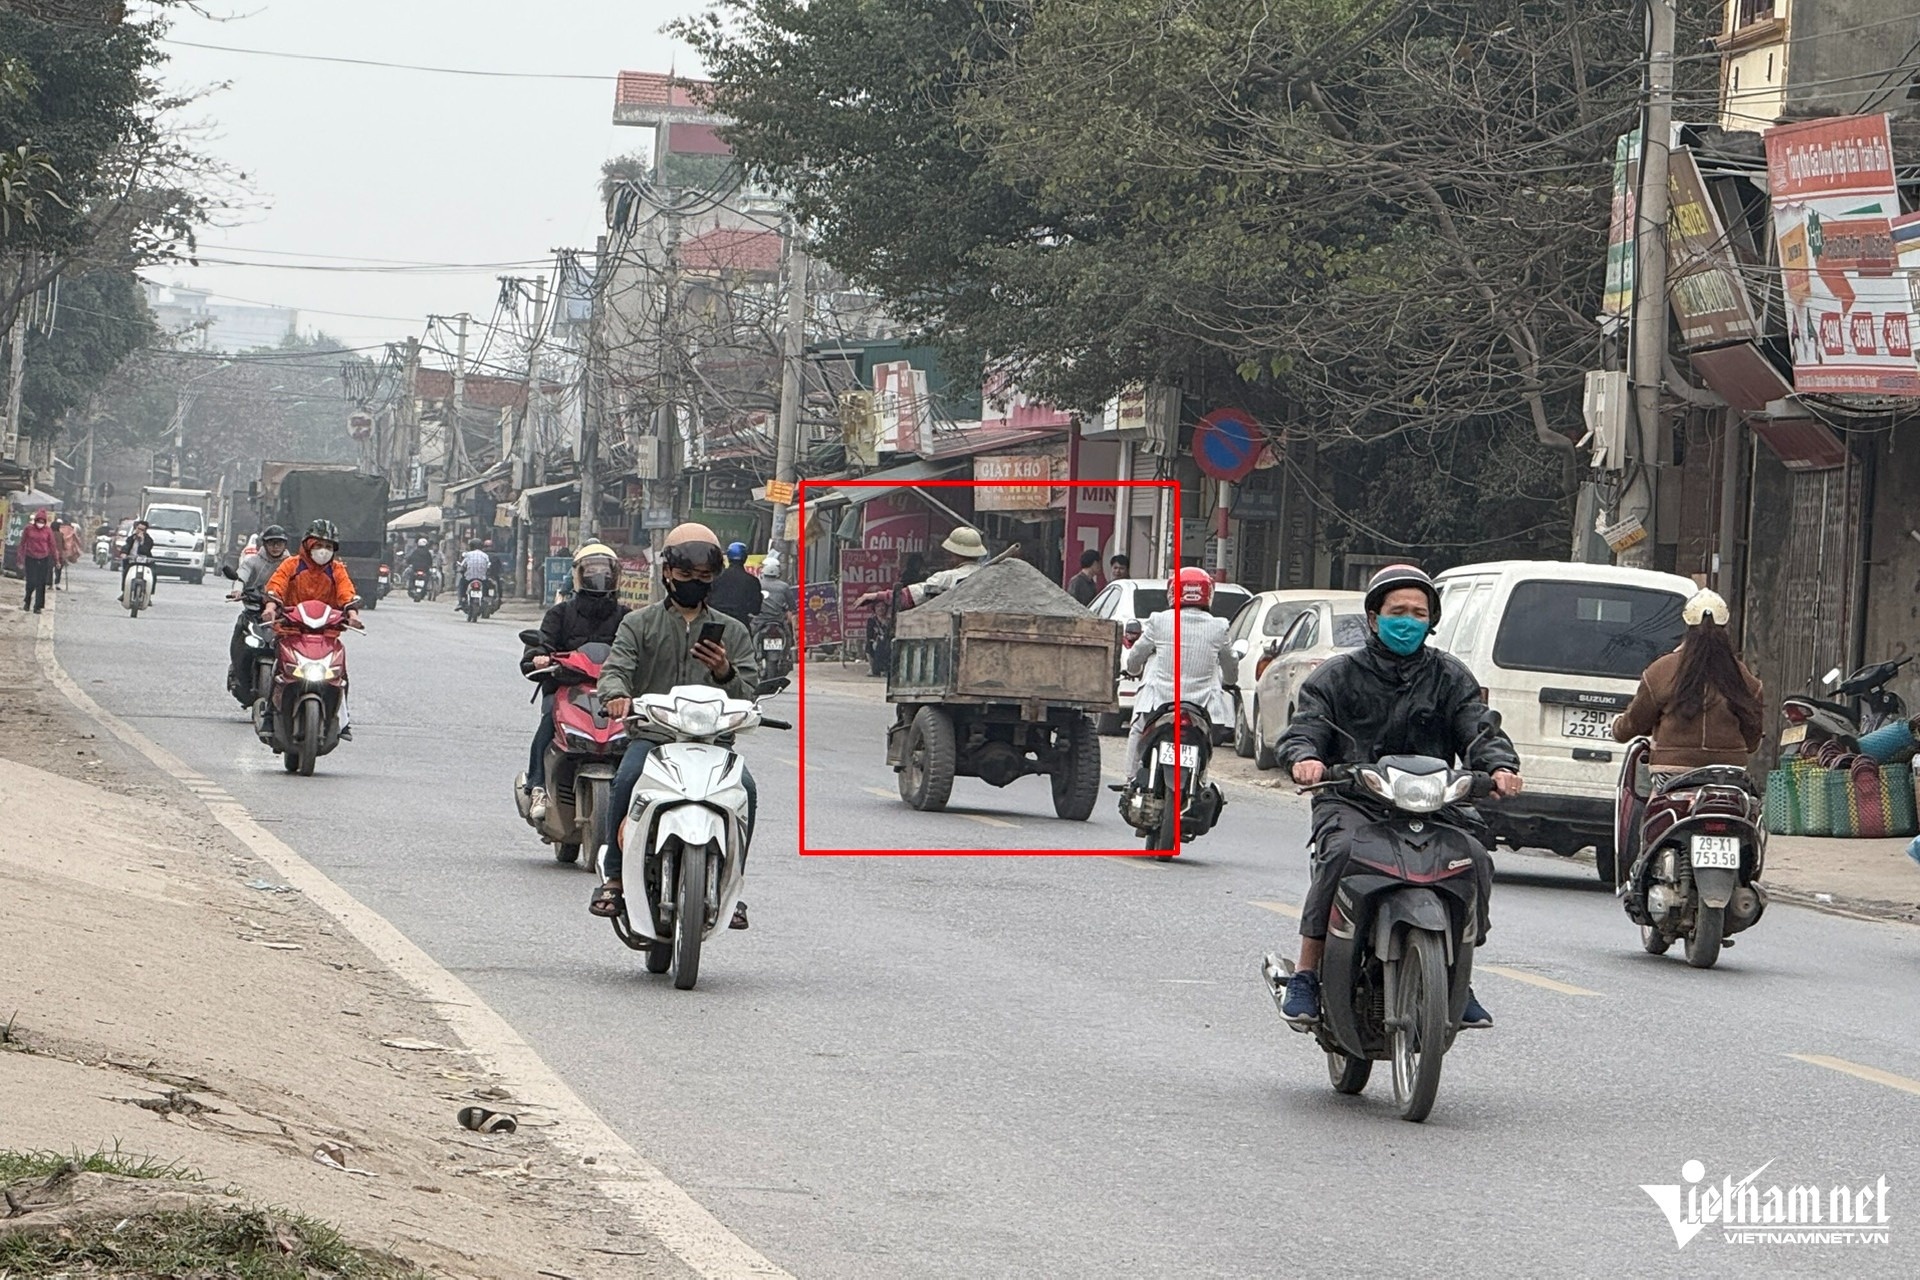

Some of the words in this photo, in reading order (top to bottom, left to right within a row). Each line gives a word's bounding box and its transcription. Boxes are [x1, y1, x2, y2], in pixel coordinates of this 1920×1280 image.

[1823, 319, 1843, 348] 39K
[1853, 319, 1875, 348] 39K
[1887, 319, 1909, 349] 39K
[1578, 694, 1616, 704] SUZUKI
[1580, 710, 1607, 725] 29D
[1569, 722, 1614, 739] 232.
[1700, 837, 1732, 851] 29-X1
[1695, 851, 1737, 866] 753.58
